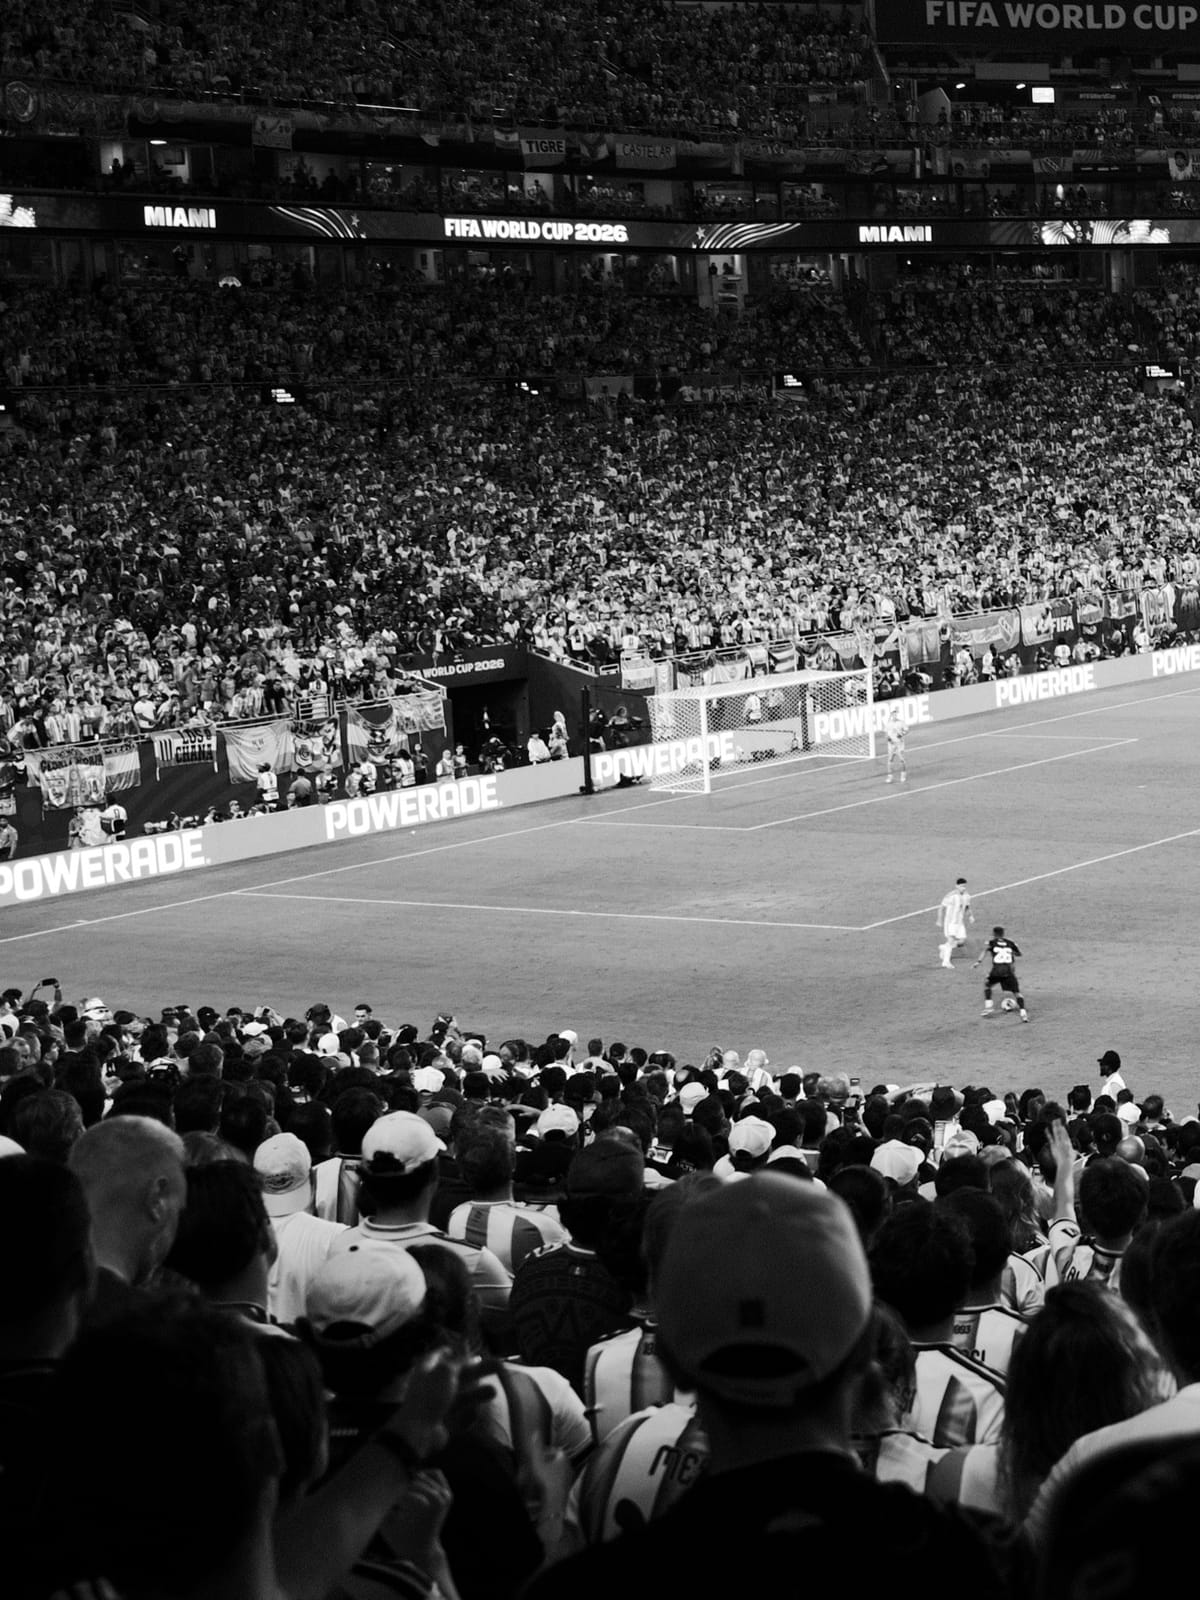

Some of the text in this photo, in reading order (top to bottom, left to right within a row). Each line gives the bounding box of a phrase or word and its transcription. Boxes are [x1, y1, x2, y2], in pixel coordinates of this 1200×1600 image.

[925, 0, 999, 27] FIFA
[1004, 2, 1127, 30] WORLD
[1133, 4, 1198, 31] CUP
[526, 139, 564, 153] TIGRE
[143, 205, 217, 229] MIAMI
[444, 217, 629, 243] FIFA WORLD CUP 2026
[858, 225, 933, 243] MIAMI
[1051, 614, 1074, 632] FIFA
[422, 665, 456, 679] WORLD
[456, 662, 474, 675] CUP
[474, 658, 505, 672] 2026
